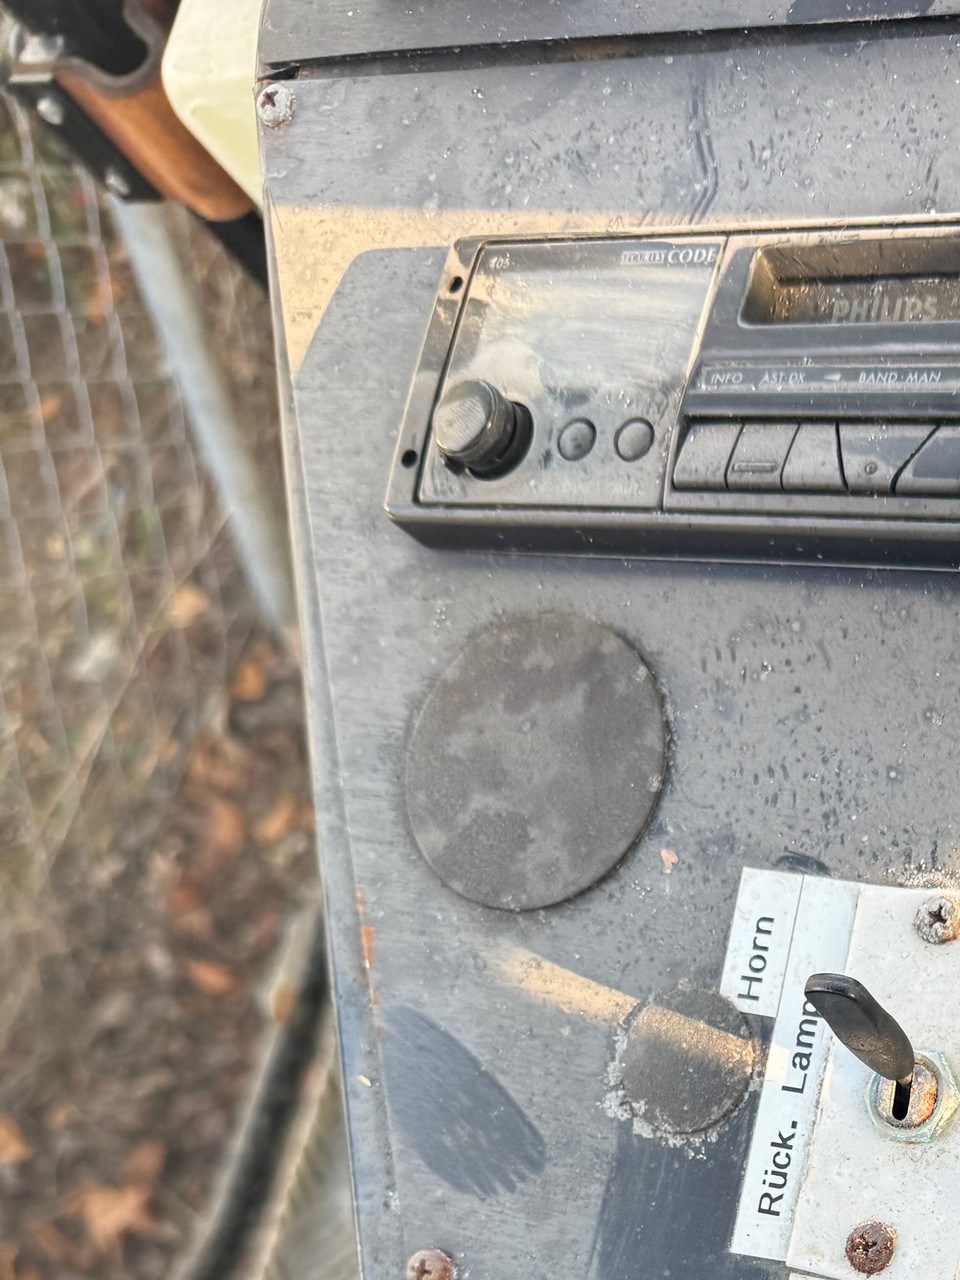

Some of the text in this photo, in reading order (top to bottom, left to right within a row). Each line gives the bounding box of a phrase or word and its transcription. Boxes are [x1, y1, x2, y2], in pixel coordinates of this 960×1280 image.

[668, 248, 717, 264] CODE
[832, 297, 938, 322] PHILIPS
[711, 373, 743, 384] INFO
[737, 916, 775, 1001] Horn
[758, 1120, 798, 1217] Rück.
